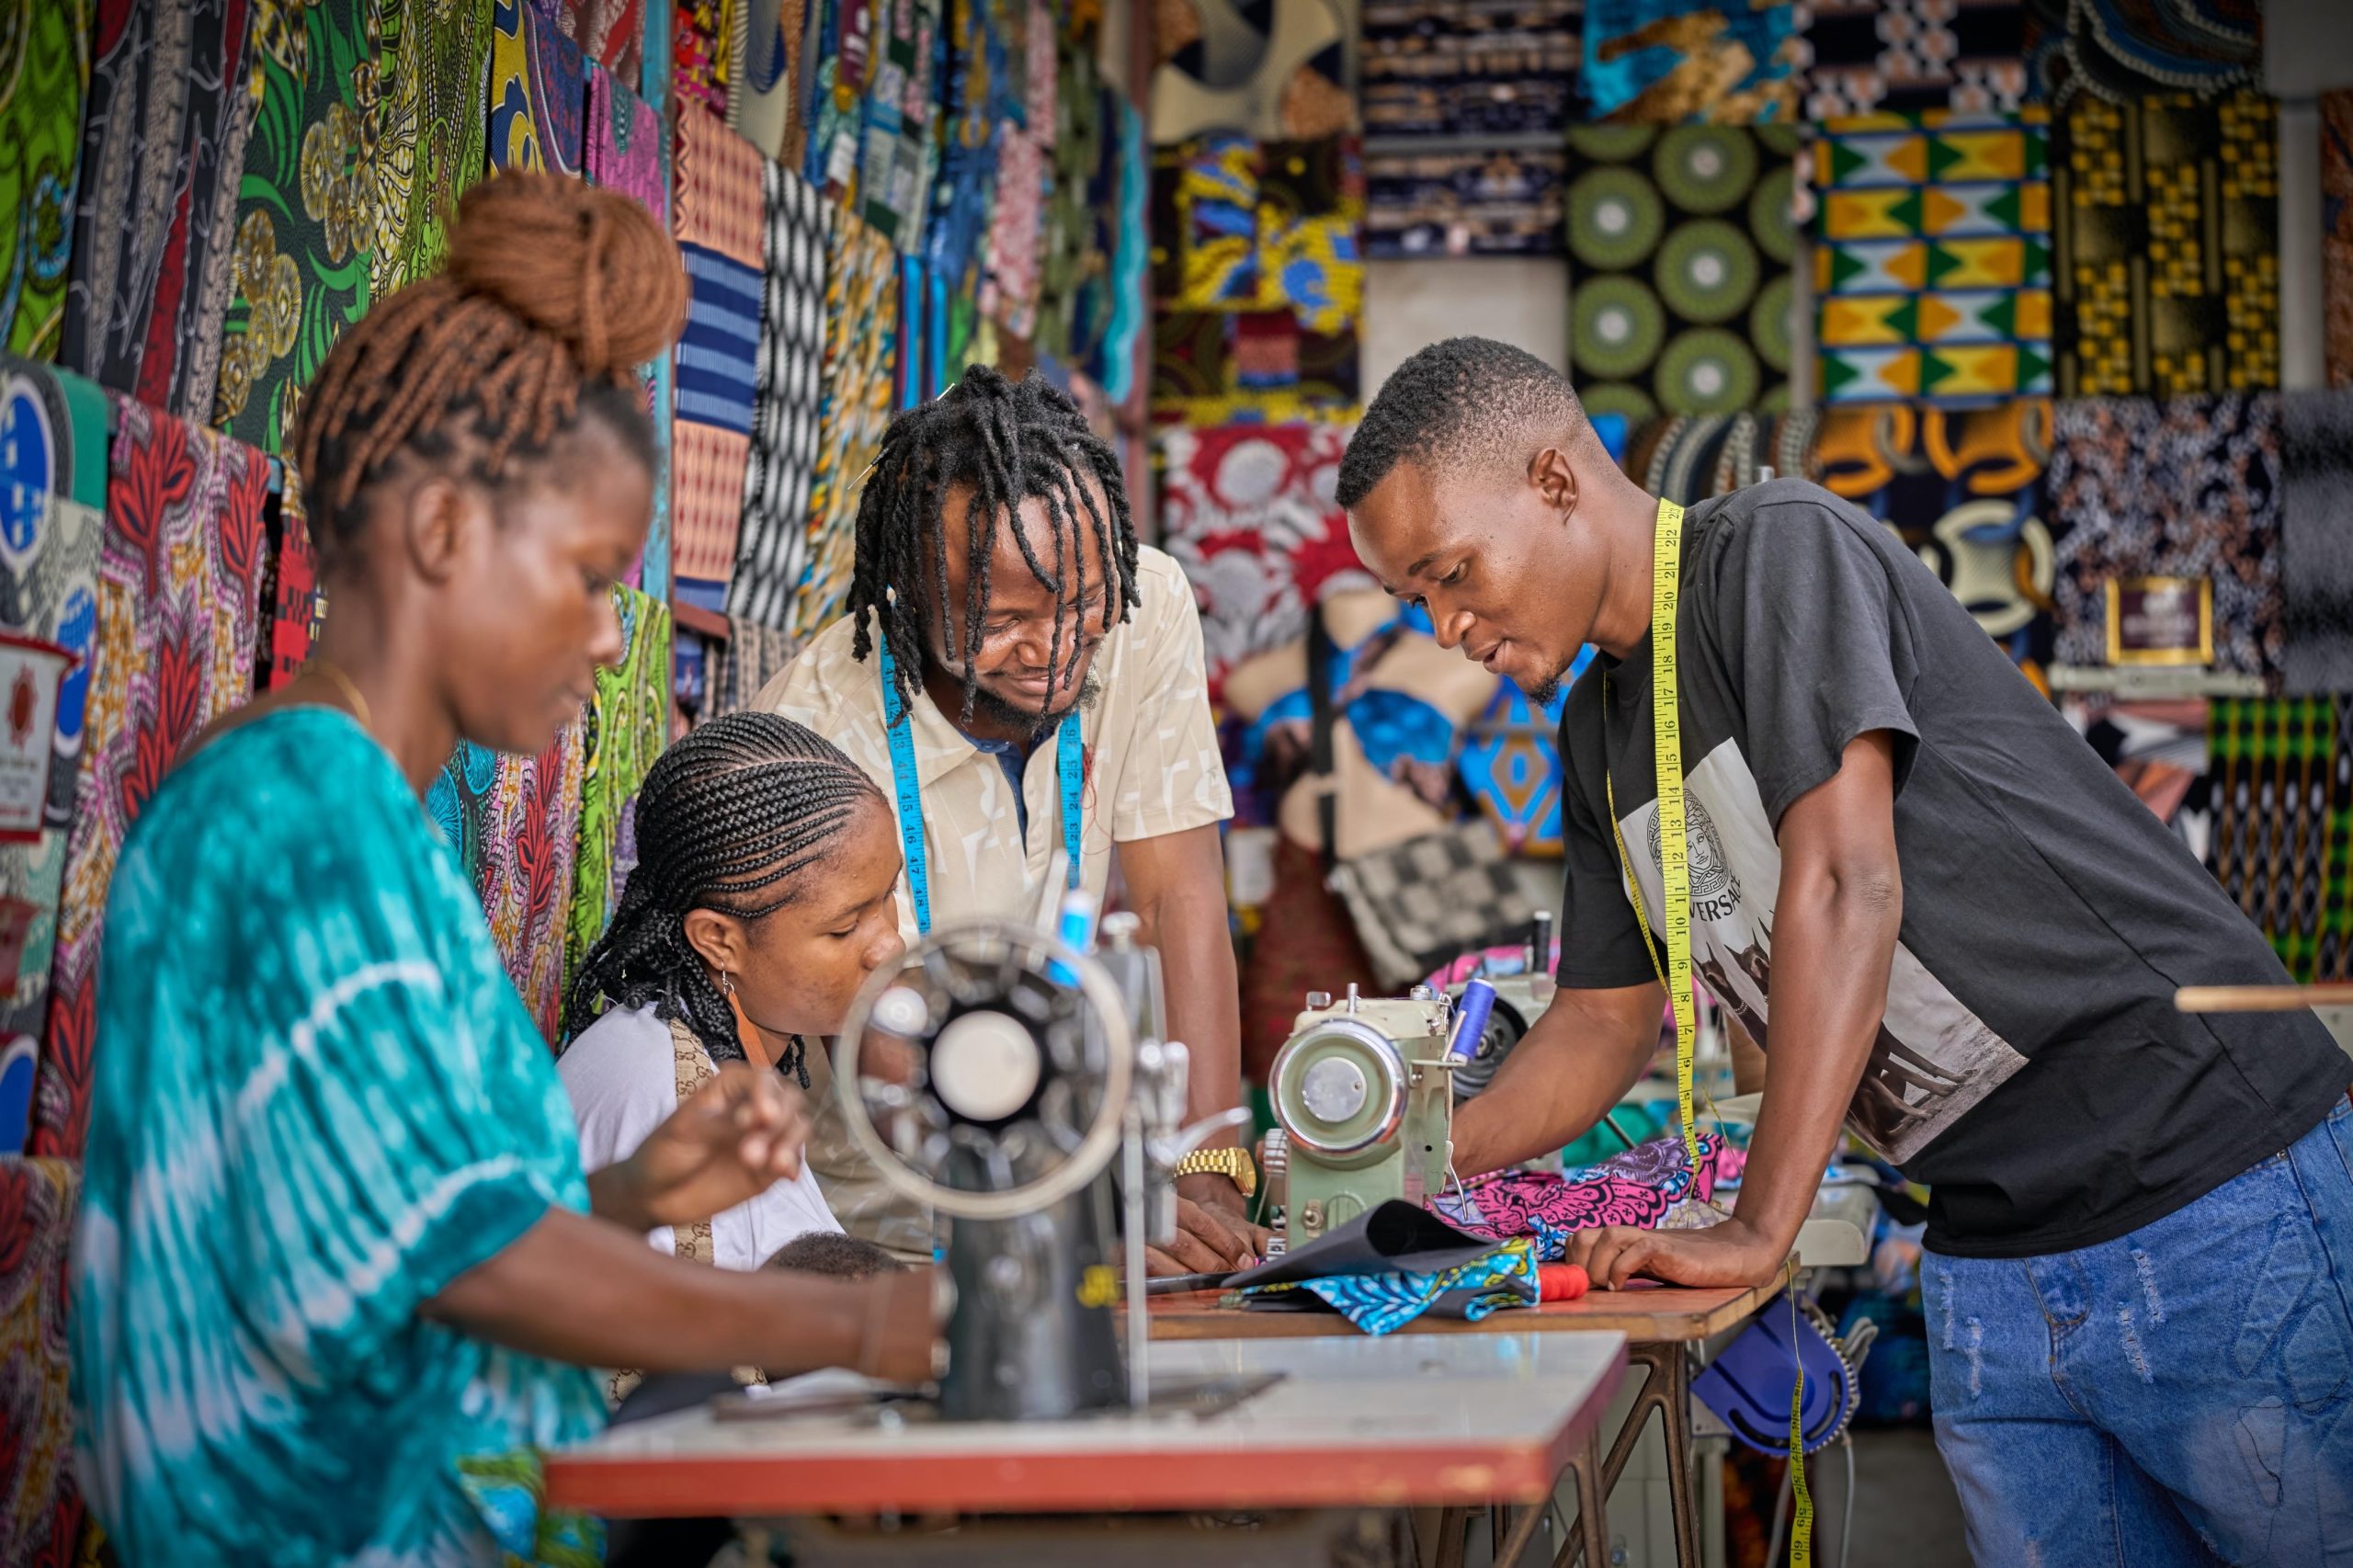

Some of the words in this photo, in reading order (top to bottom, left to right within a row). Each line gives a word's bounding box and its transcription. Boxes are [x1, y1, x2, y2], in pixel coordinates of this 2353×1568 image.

[1668, 507, 1681, 519] 23
[1665, 529, 1677, 547] 22
[1665, 560, 1676, 579] 21
[1664, 591, 1675, 610] 20
[1662, 622, 1673, 642] 19
[1663, 654, 1674, 674] 18
[1664, 687, 1675, 707] 17
[1066, 729, 1077, 747] 26
[1665, 720, 1677, 740] 16
[892, 730, 905, 750] 43
[897, 760, 909, 780] 44
[1067, 760, 1078, 779] 25
[1665, 753, 1678, 773] 15
[901, 793, 914, 812] 45
[1068, 791, 1078, 810] 24
[1668, 786, 1680, 806] 14
[905, 824, 917, 845] 46
[1069, 823, 1078, 841] 23
[1670, 819, 1683, 838] 13
[910, 856, 920, 875] 47
[1673, 851, 1685, 871] 12
[915, 888, 925, 907] 48
[1675, 885, 1687, 904] 11
[1689, 869, 1741, 922] VERSACE
[1677, 917, 1688, 937] 10
[1677, 961, 1688, 970] 9
[1681, 994, 1690, 1003] 8
[1685, 1028, 1693, 1036] 7
[1797, 1507, 1807, 1528] 59
[1793, 1540, 1803, 1560] 60
